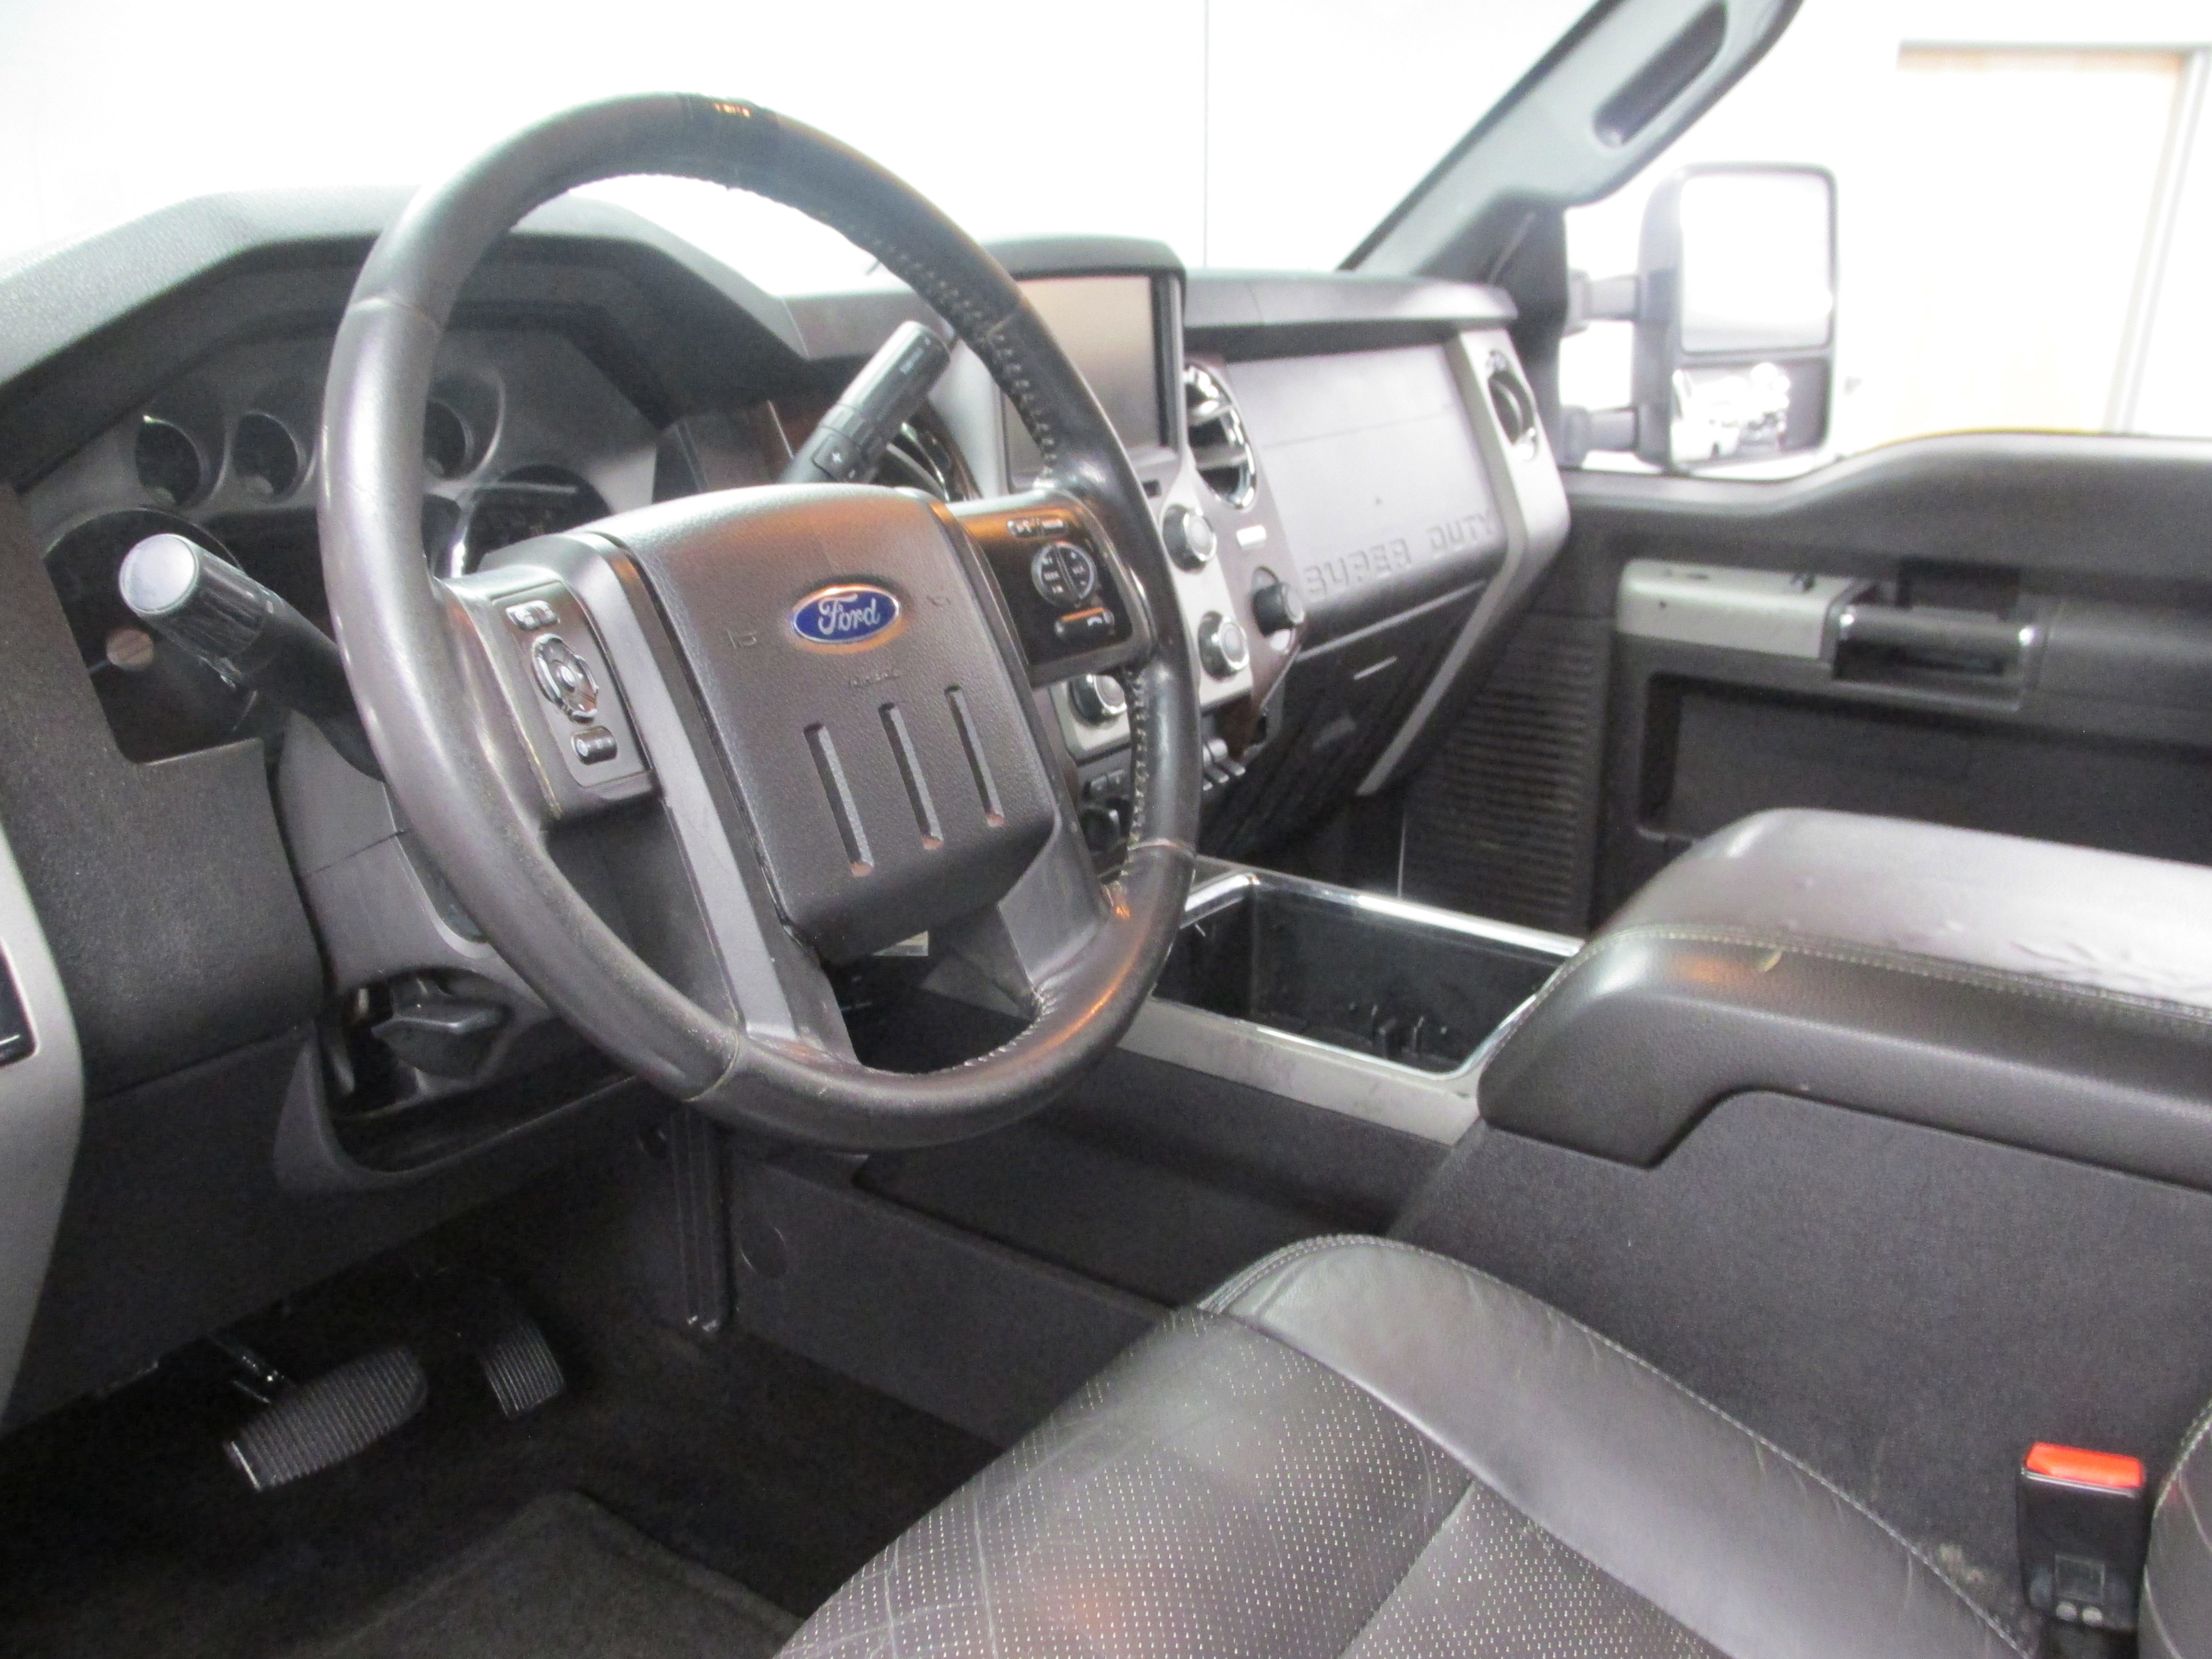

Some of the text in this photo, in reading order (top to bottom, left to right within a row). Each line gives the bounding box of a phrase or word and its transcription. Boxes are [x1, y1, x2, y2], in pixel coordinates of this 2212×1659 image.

[1304, 512, 1496, 598] SUPER DUTY
[817, 593, 881, 635] Ford
